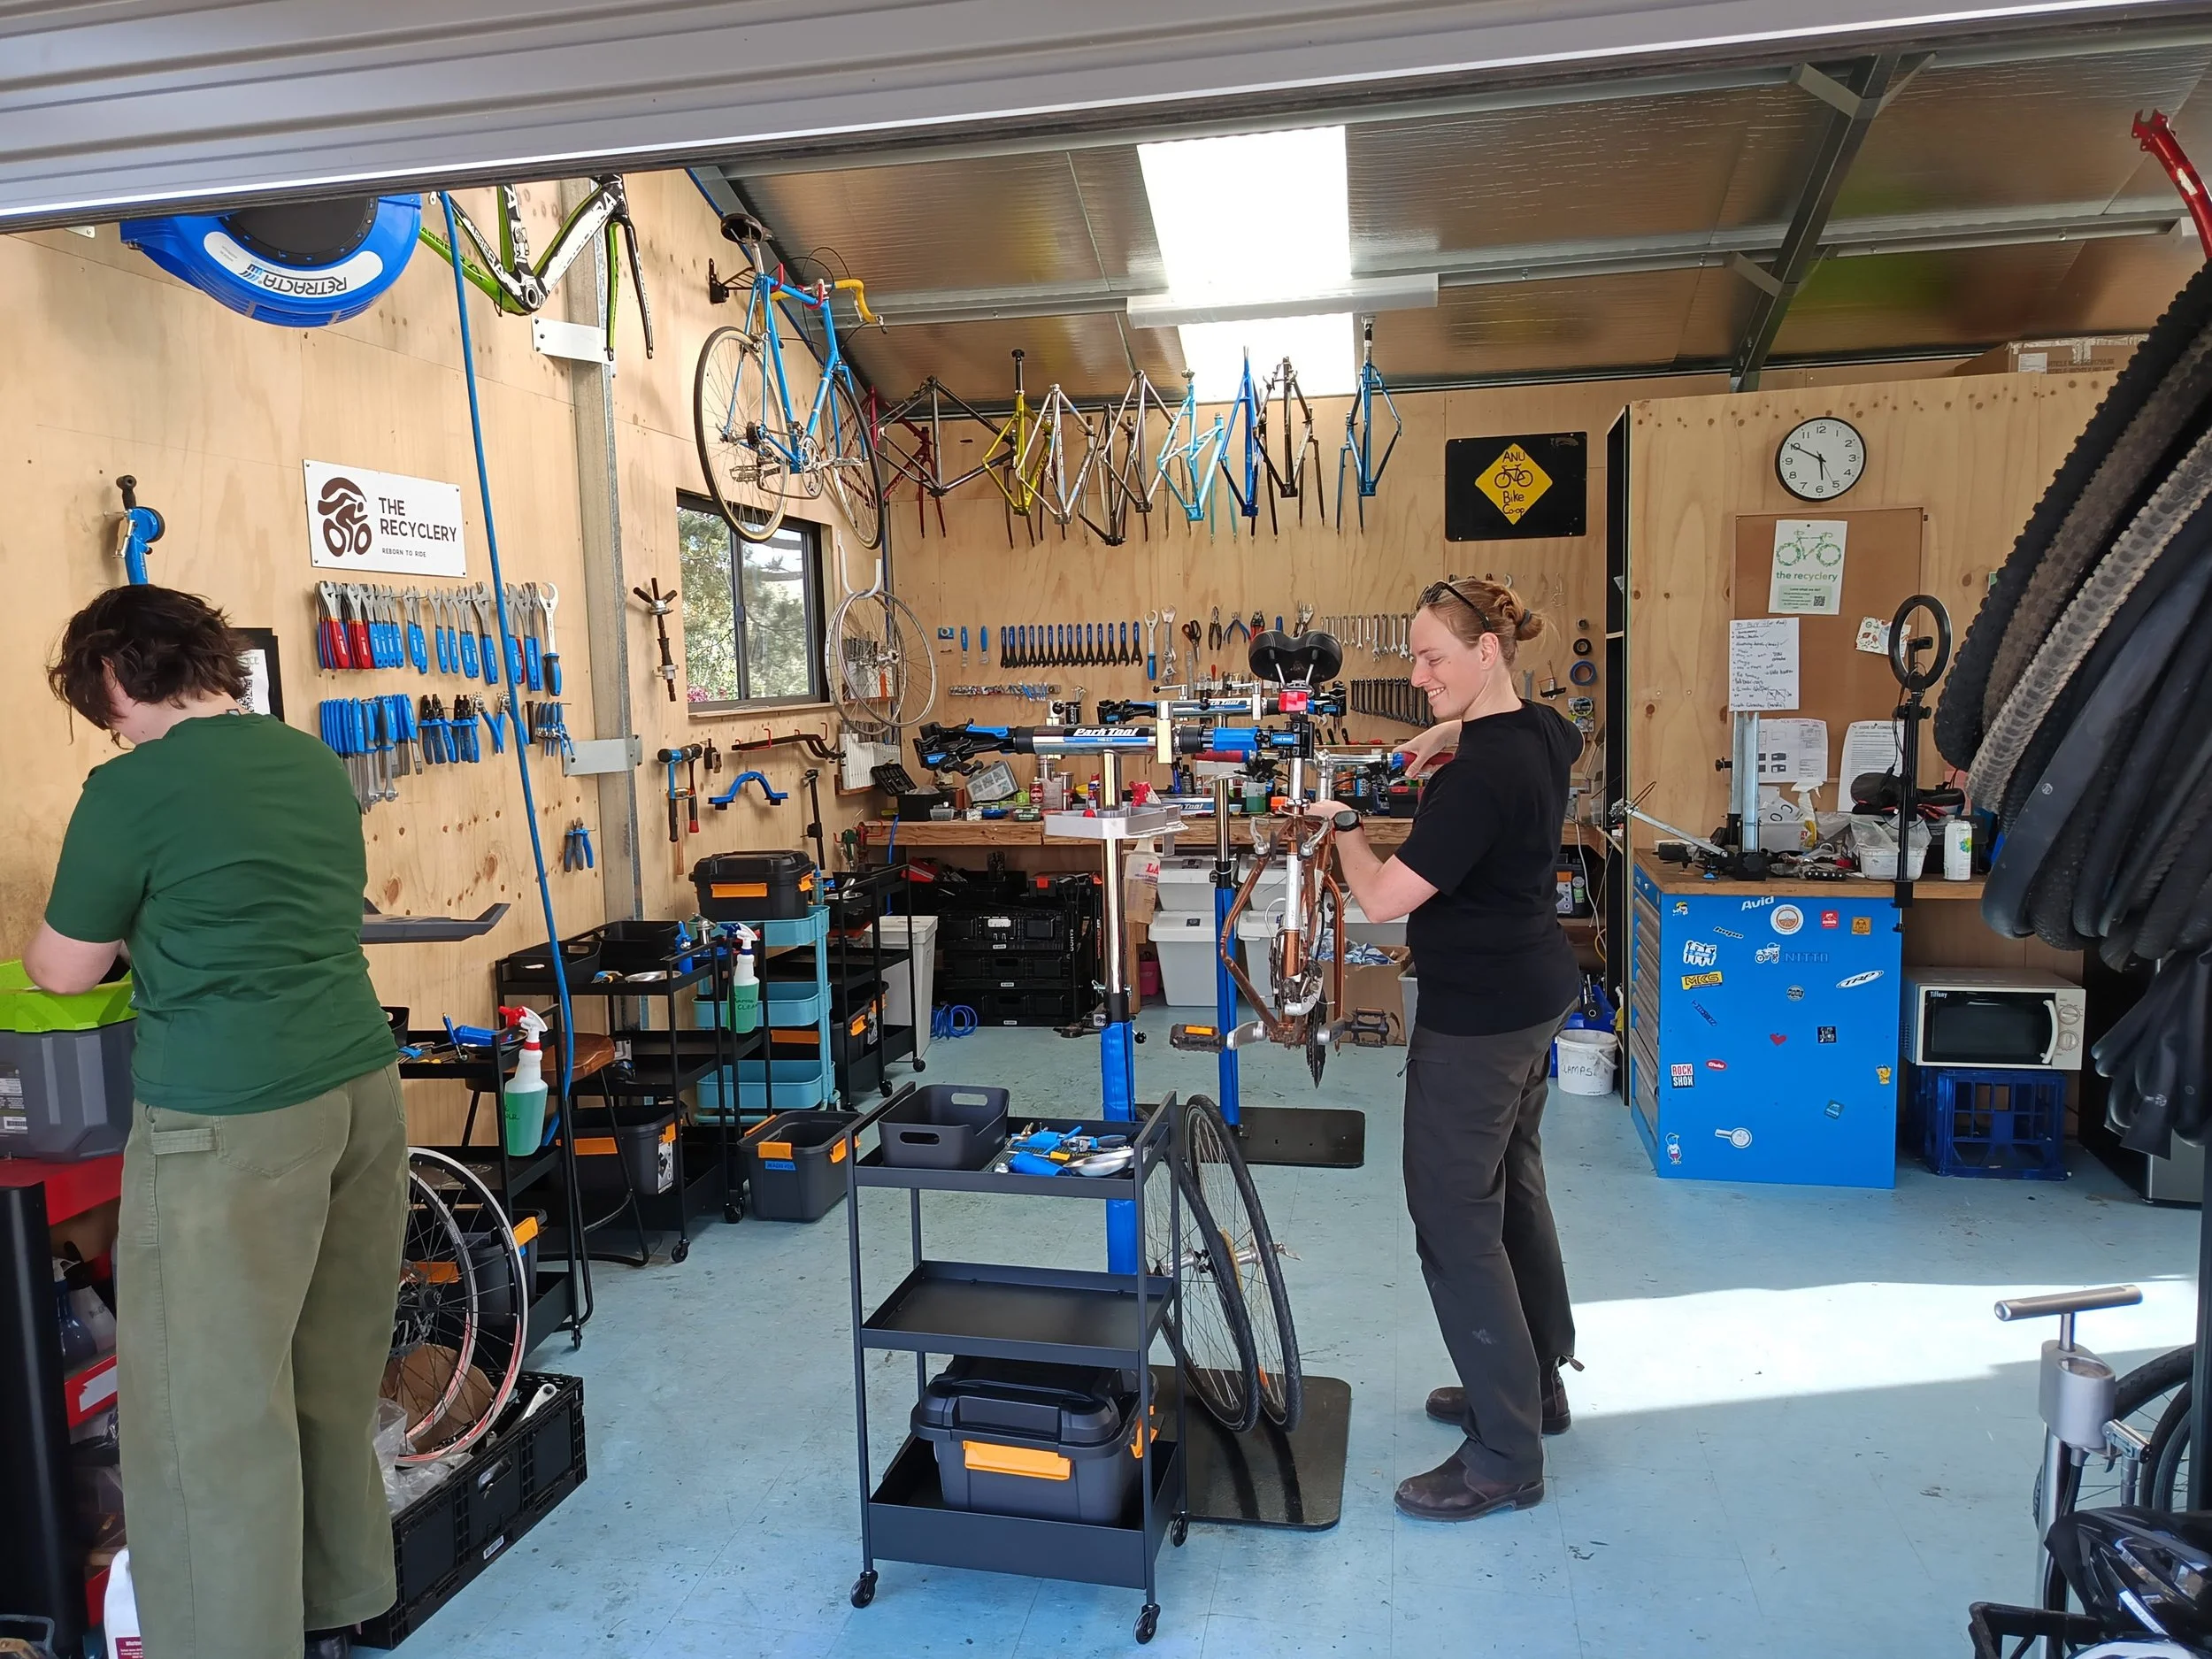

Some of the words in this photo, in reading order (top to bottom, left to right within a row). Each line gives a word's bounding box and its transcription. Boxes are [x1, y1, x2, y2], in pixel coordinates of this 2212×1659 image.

[1845, 439, 1853, 448] 2
[1502, 450, 1525, 463] ANU
[1502, 489, 1525, 503] Bike
[378, 497, 406, 516] THE
[1502, 503, 1525, 517] Co-op
[380, 518, 457, 542] RECYCLERY
[1776, 571, 1792, 580] the
[1793, 572, 1839, 582] recyclery
[1072, 727, 1106, 737] Park
[1106, 727, 1140, 737] Tool
[1741, 896, 1775, 911] Avid
[1785, 953, 1828, 962] NITTO
[1685, 973, 1719, 986] MKS
[1845, 972, 1876, 986] TRP
[1672, 1064, 1693, 1076] ROCK
